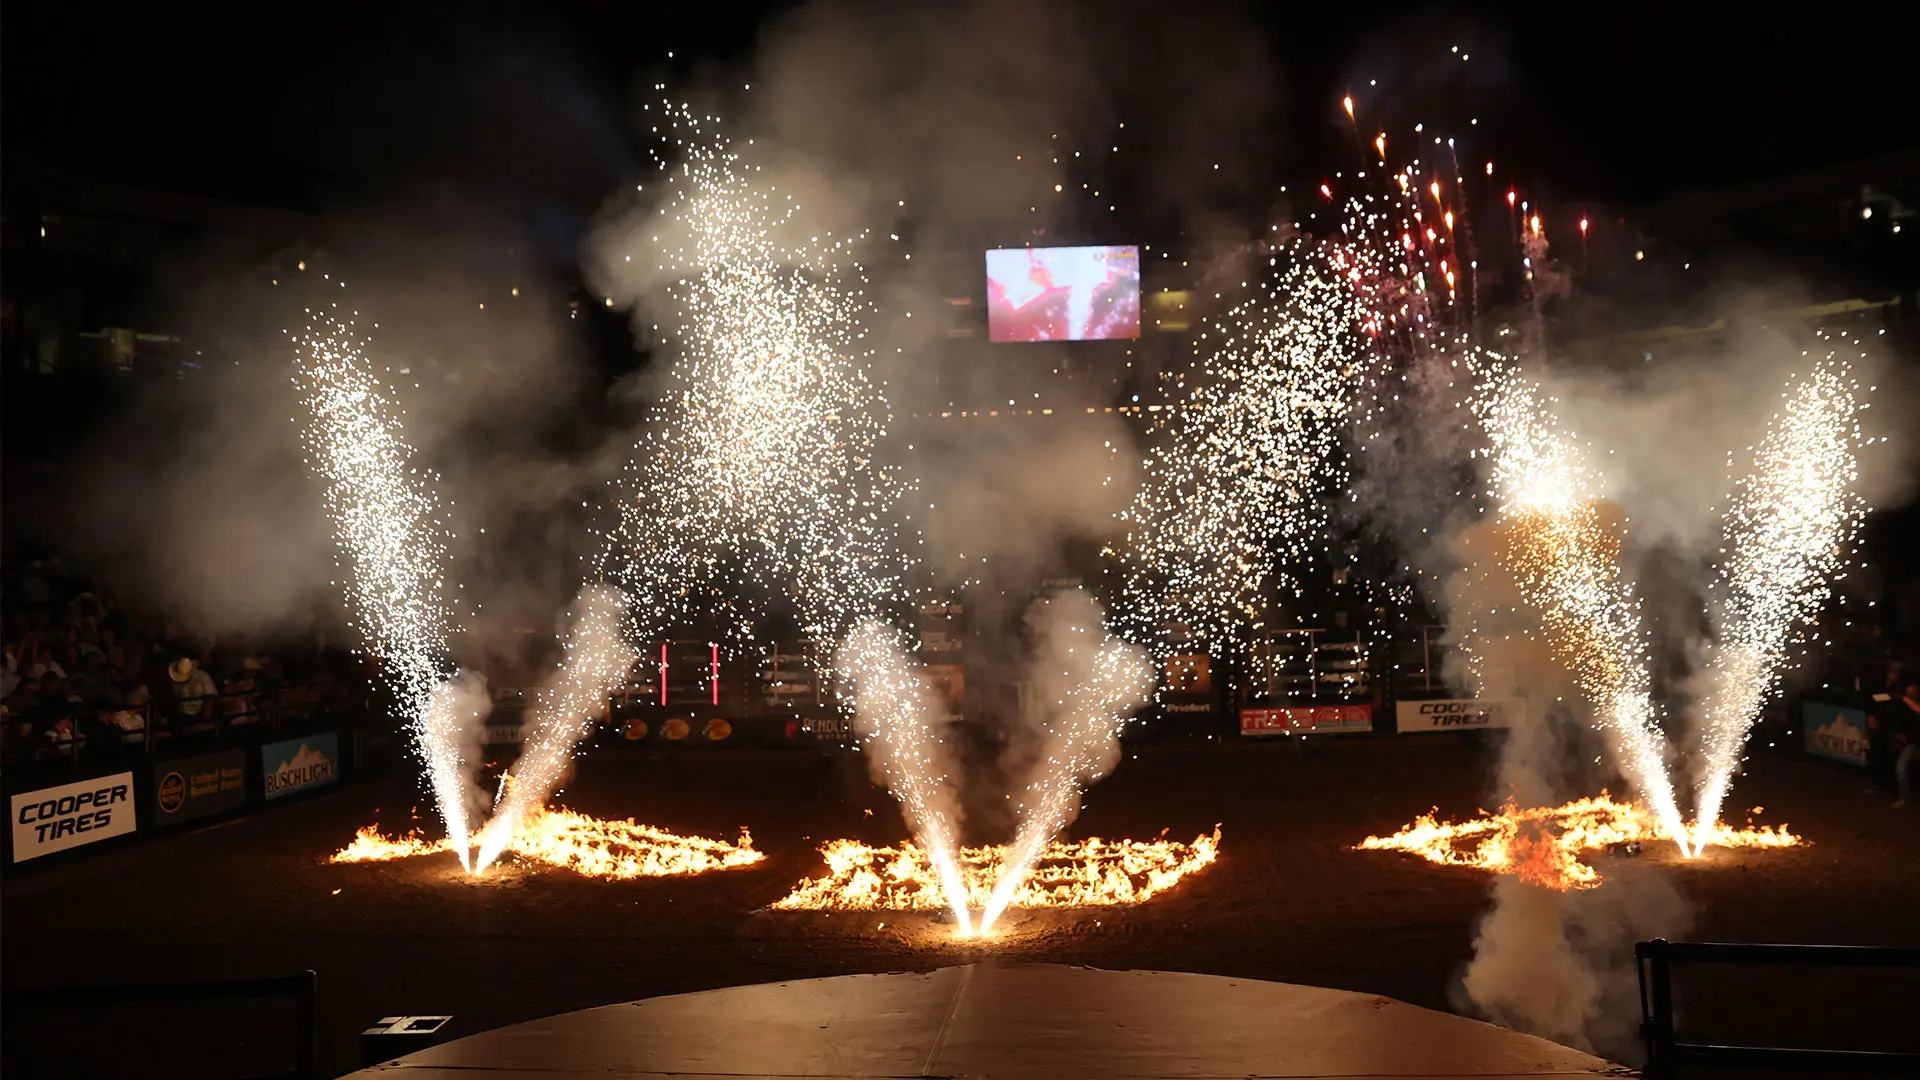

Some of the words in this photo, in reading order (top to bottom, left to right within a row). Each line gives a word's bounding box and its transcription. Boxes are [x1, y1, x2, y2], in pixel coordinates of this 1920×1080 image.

[1430, 714, 1490, 726] TIRES
[267, 769, 301, 793] BUSCH
[302, 761, 335, 784] LIGHT
[19, 785, 128, 824] COOPER
[35, 808, 112, 843] TIRES
